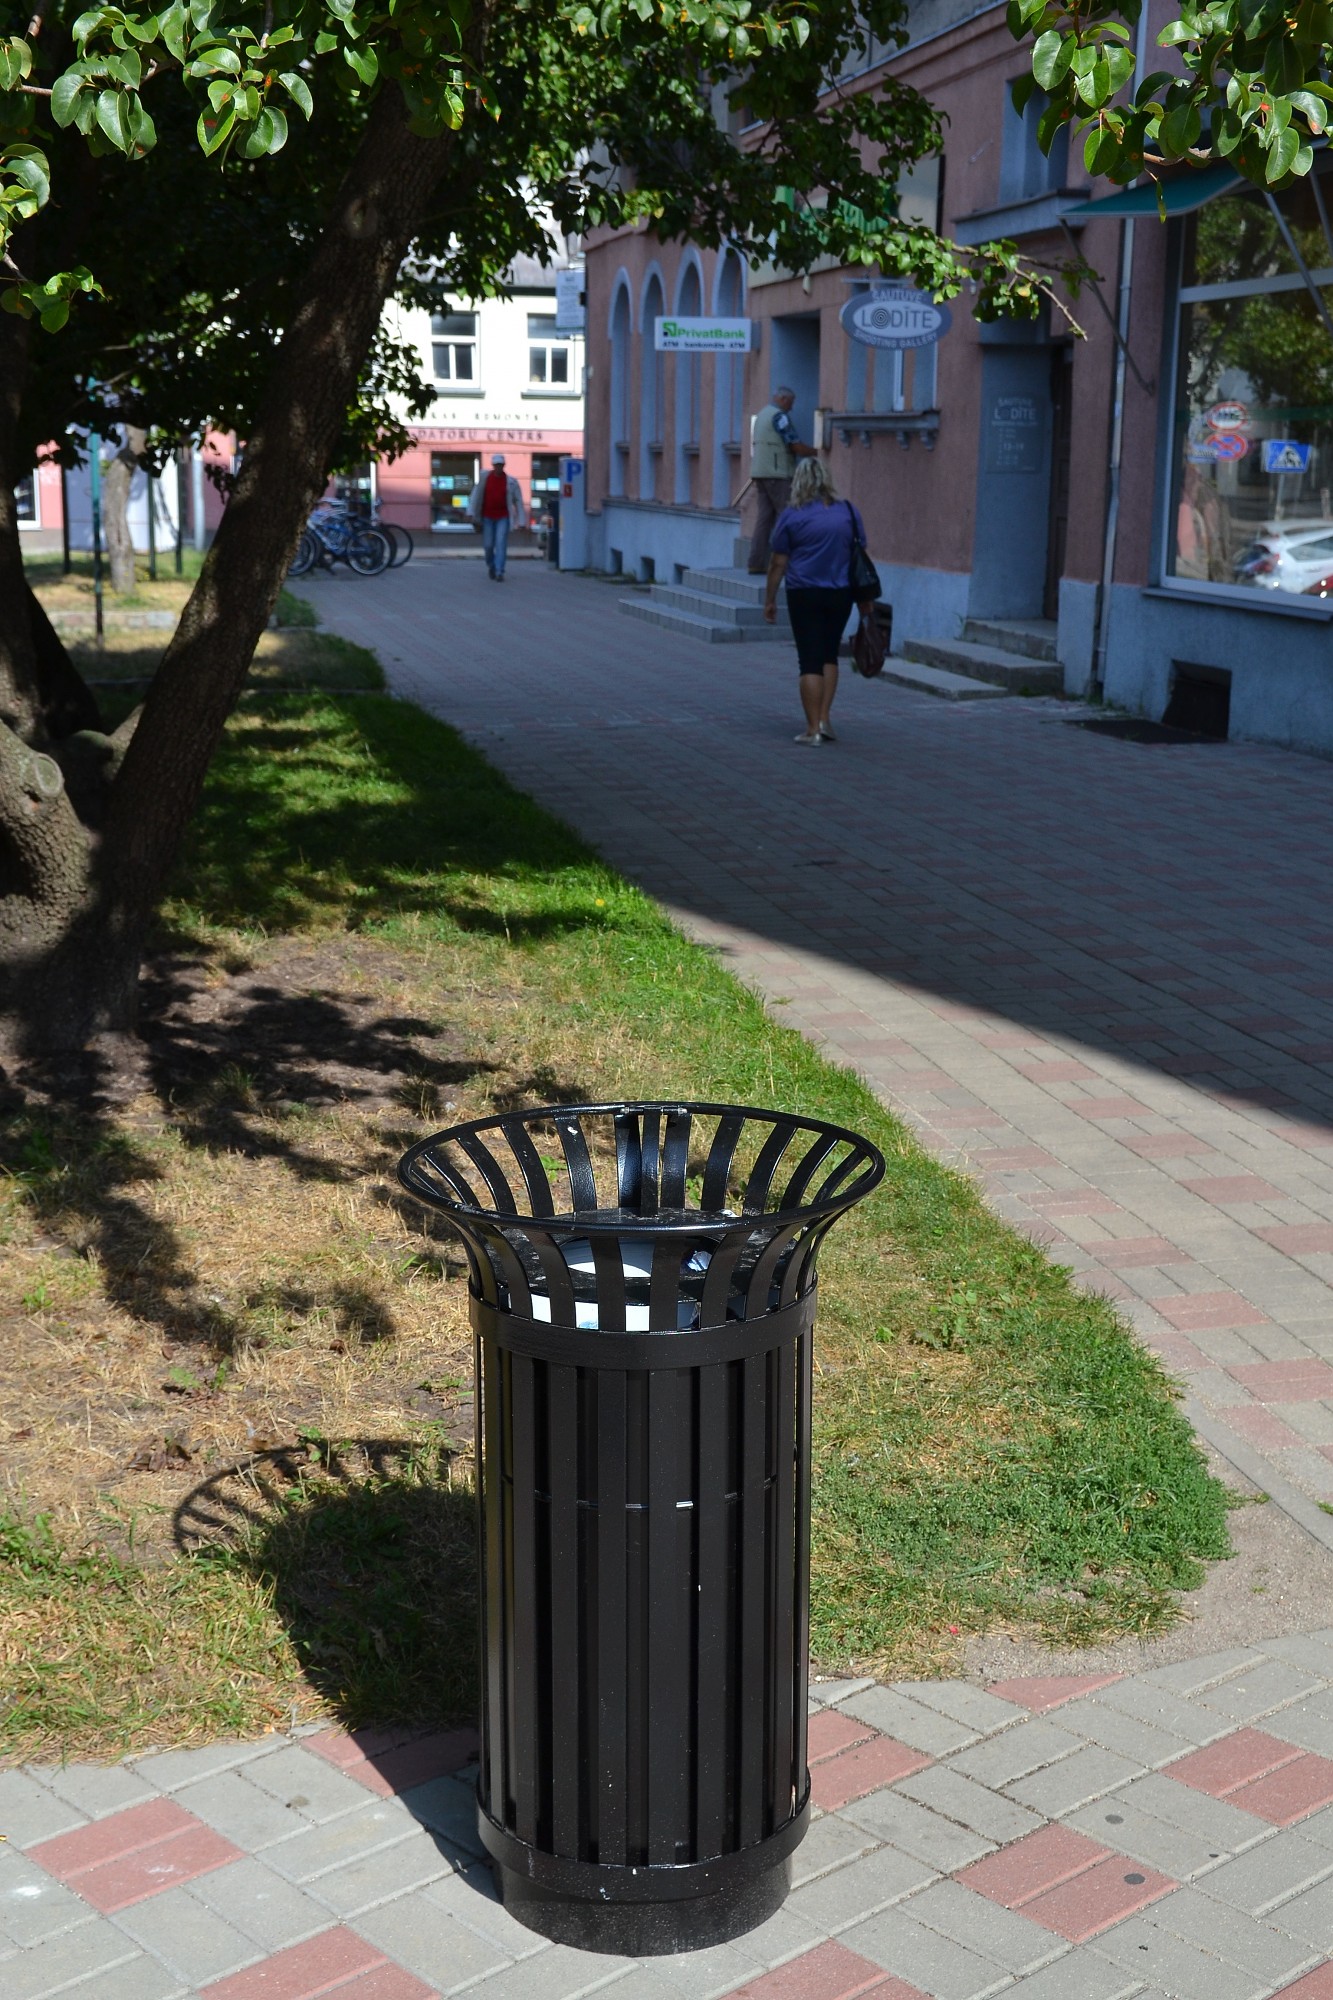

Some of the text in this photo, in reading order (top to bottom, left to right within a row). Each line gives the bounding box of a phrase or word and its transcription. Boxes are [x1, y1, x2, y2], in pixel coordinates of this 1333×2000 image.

[678, 327, 746, 339] PrivatBank
[486, 430, 543, 443] CENTRS
[566, 461, 582, 483] P
